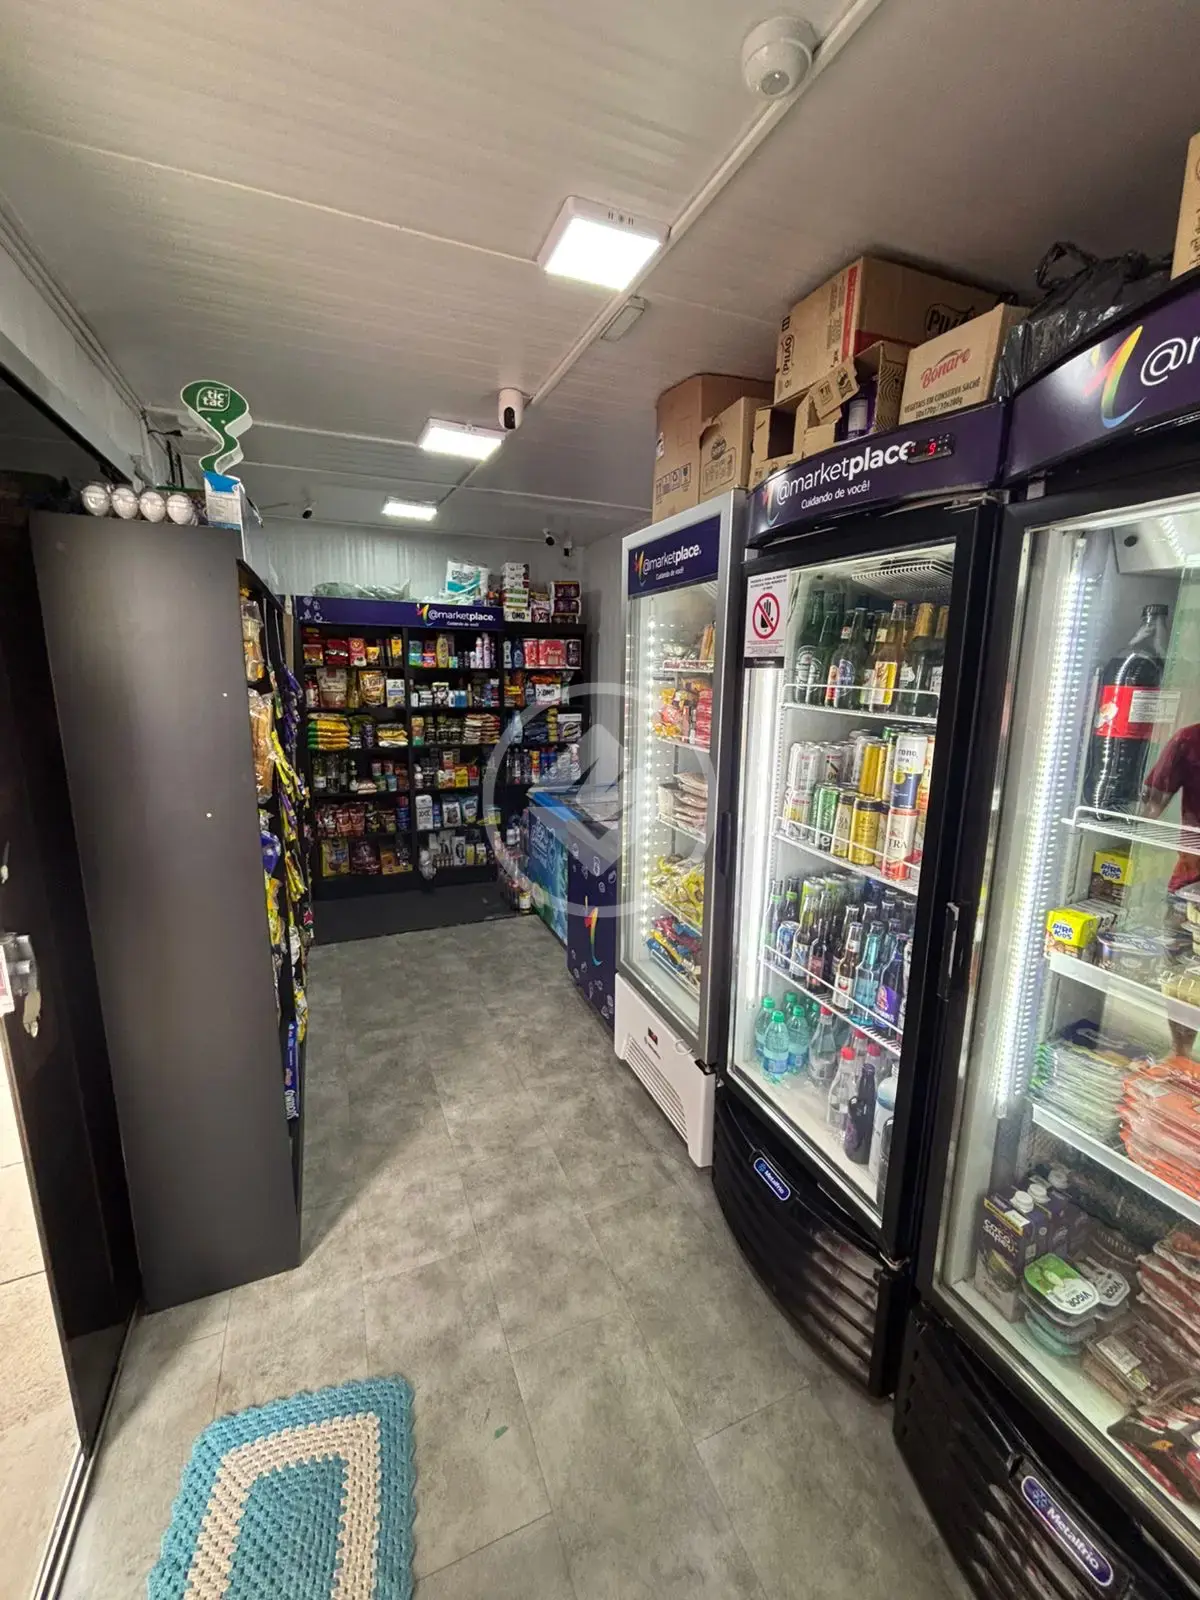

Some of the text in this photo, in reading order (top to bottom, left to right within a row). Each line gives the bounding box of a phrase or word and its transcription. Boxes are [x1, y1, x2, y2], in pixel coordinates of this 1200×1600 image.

[203, 397, 224, 407] tac
[207, 390, 225, 400] tic
[801, 479, 871, 510] Cuidando de você!
[1069, 1291, 1092, 1307] VIGOR
[1047, 1508, 1099, 1570] Metalfrio
